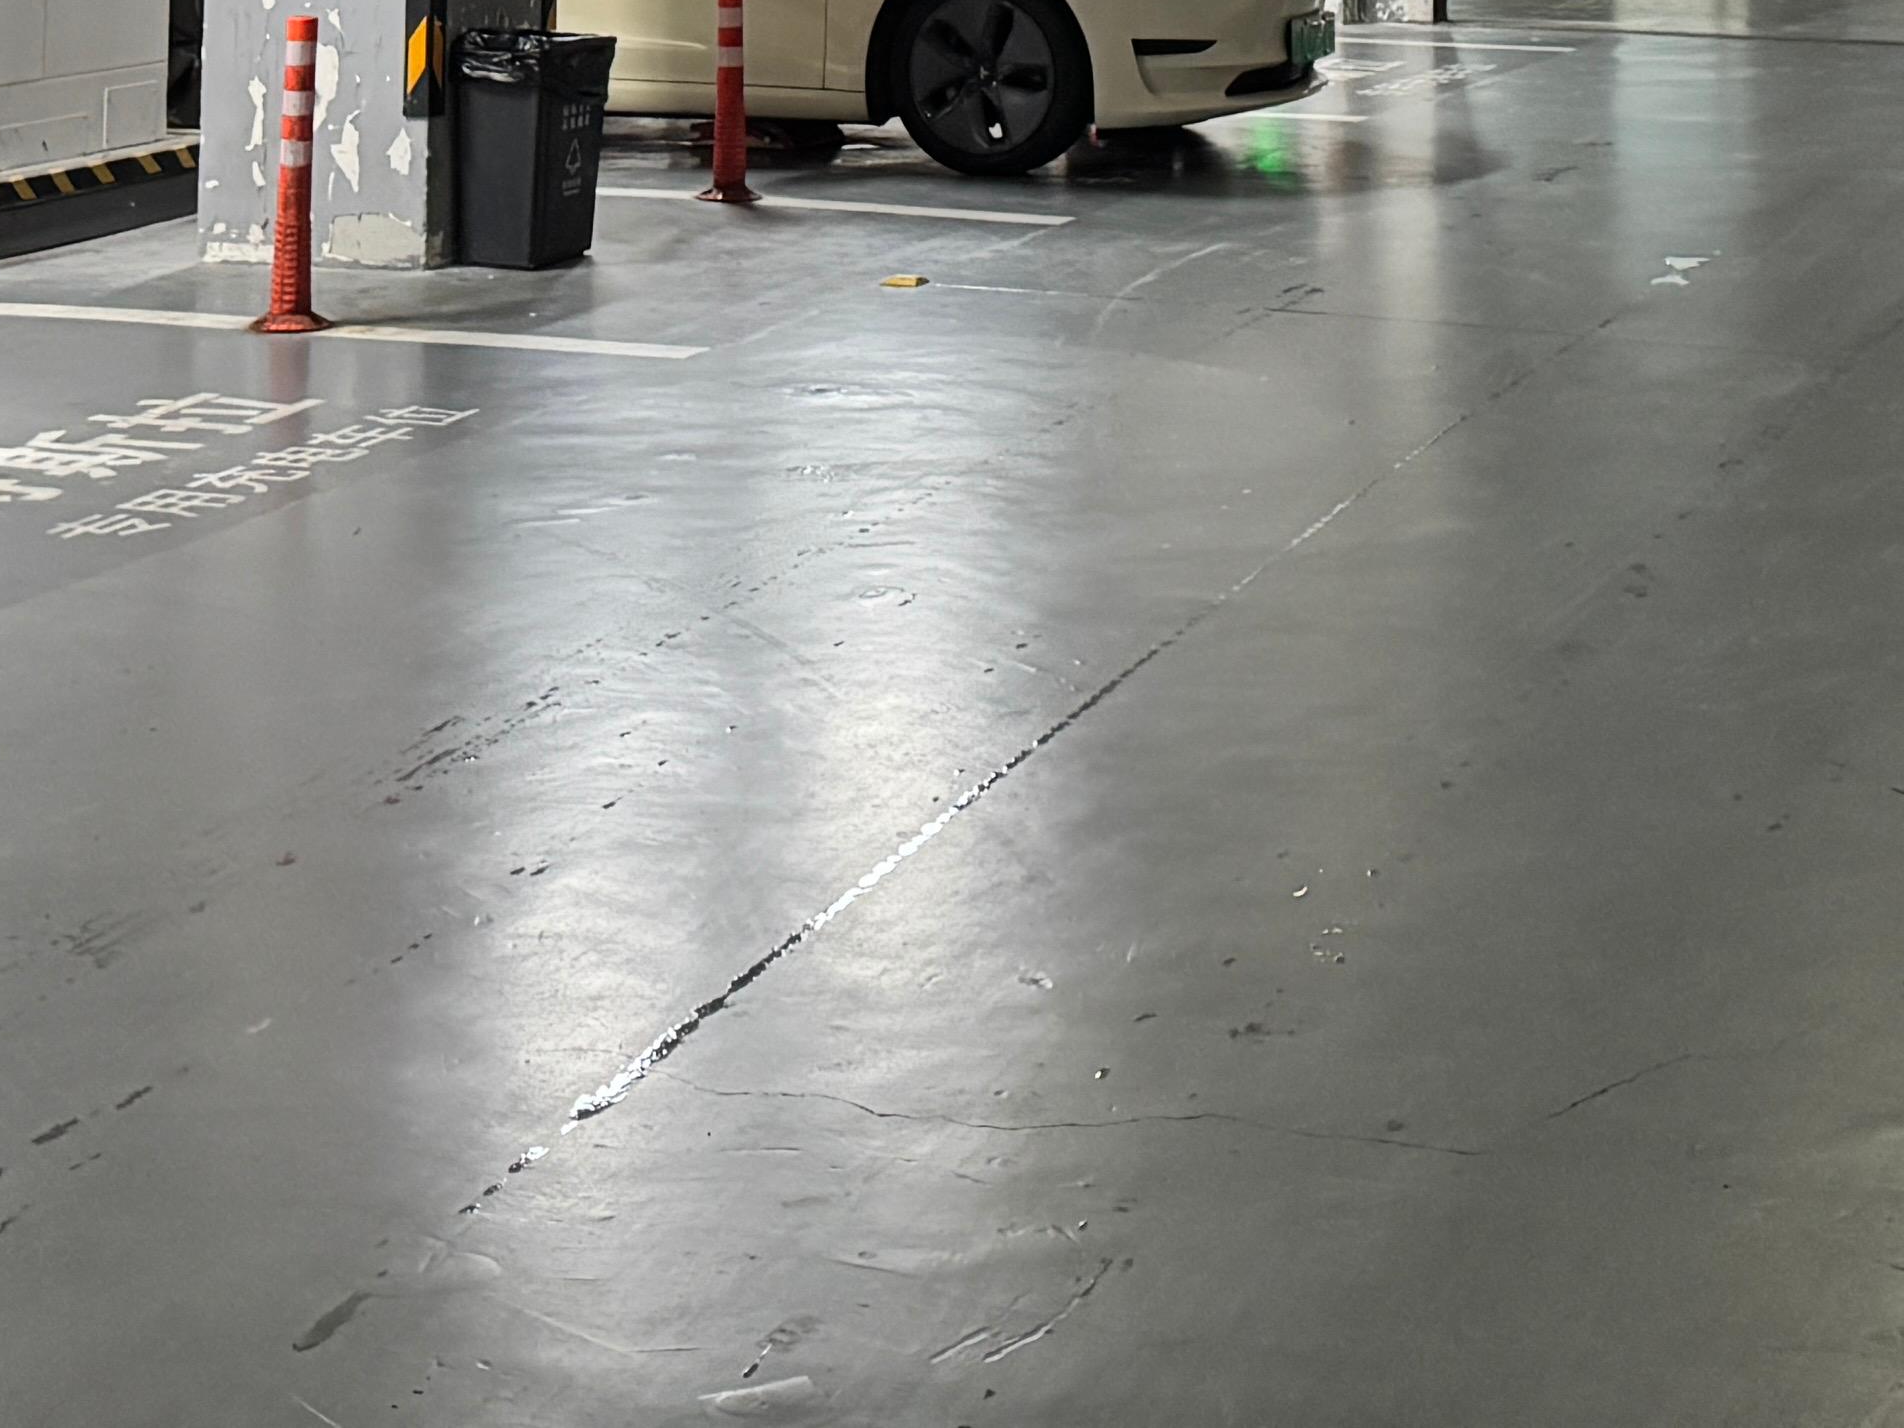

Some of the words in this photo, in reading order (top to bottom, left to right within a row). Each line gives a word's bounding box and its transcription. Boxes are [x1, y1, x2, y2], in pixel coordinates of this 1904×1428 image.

[47, 404, 479, 540] 专用充电车位
